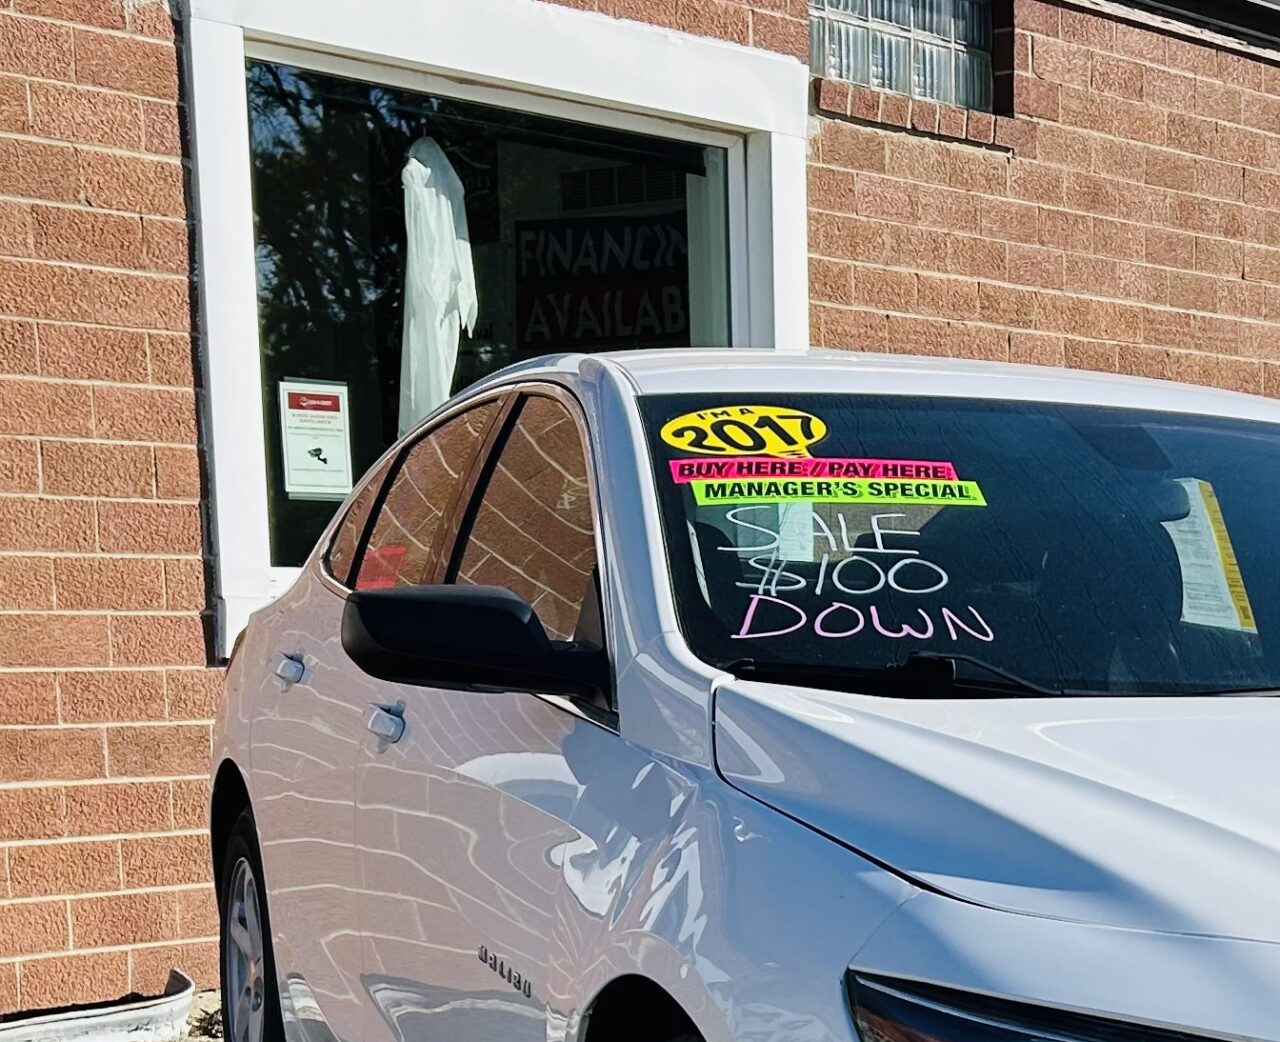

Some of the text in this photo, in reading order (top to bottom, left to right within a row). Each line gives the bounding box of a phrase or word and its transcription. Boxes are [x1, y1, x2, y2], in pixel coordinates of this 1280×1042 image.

[523, 284, 687, 343] AVAILAB
[671, 414, 816, 451] 2017
[678, 461, 729, 477] BUY
[737, 462, 803, 476] HERE
[828, 462, 873, 477] PAY
[882, 464, 947, 479] HERE
[705, 481, 970, 498] MANAGER'S SPECIAL
[716, 505, 921, 555] SALE
[735, 553, 949, 597] $100
[730, 594, 994, 641] DOWN
